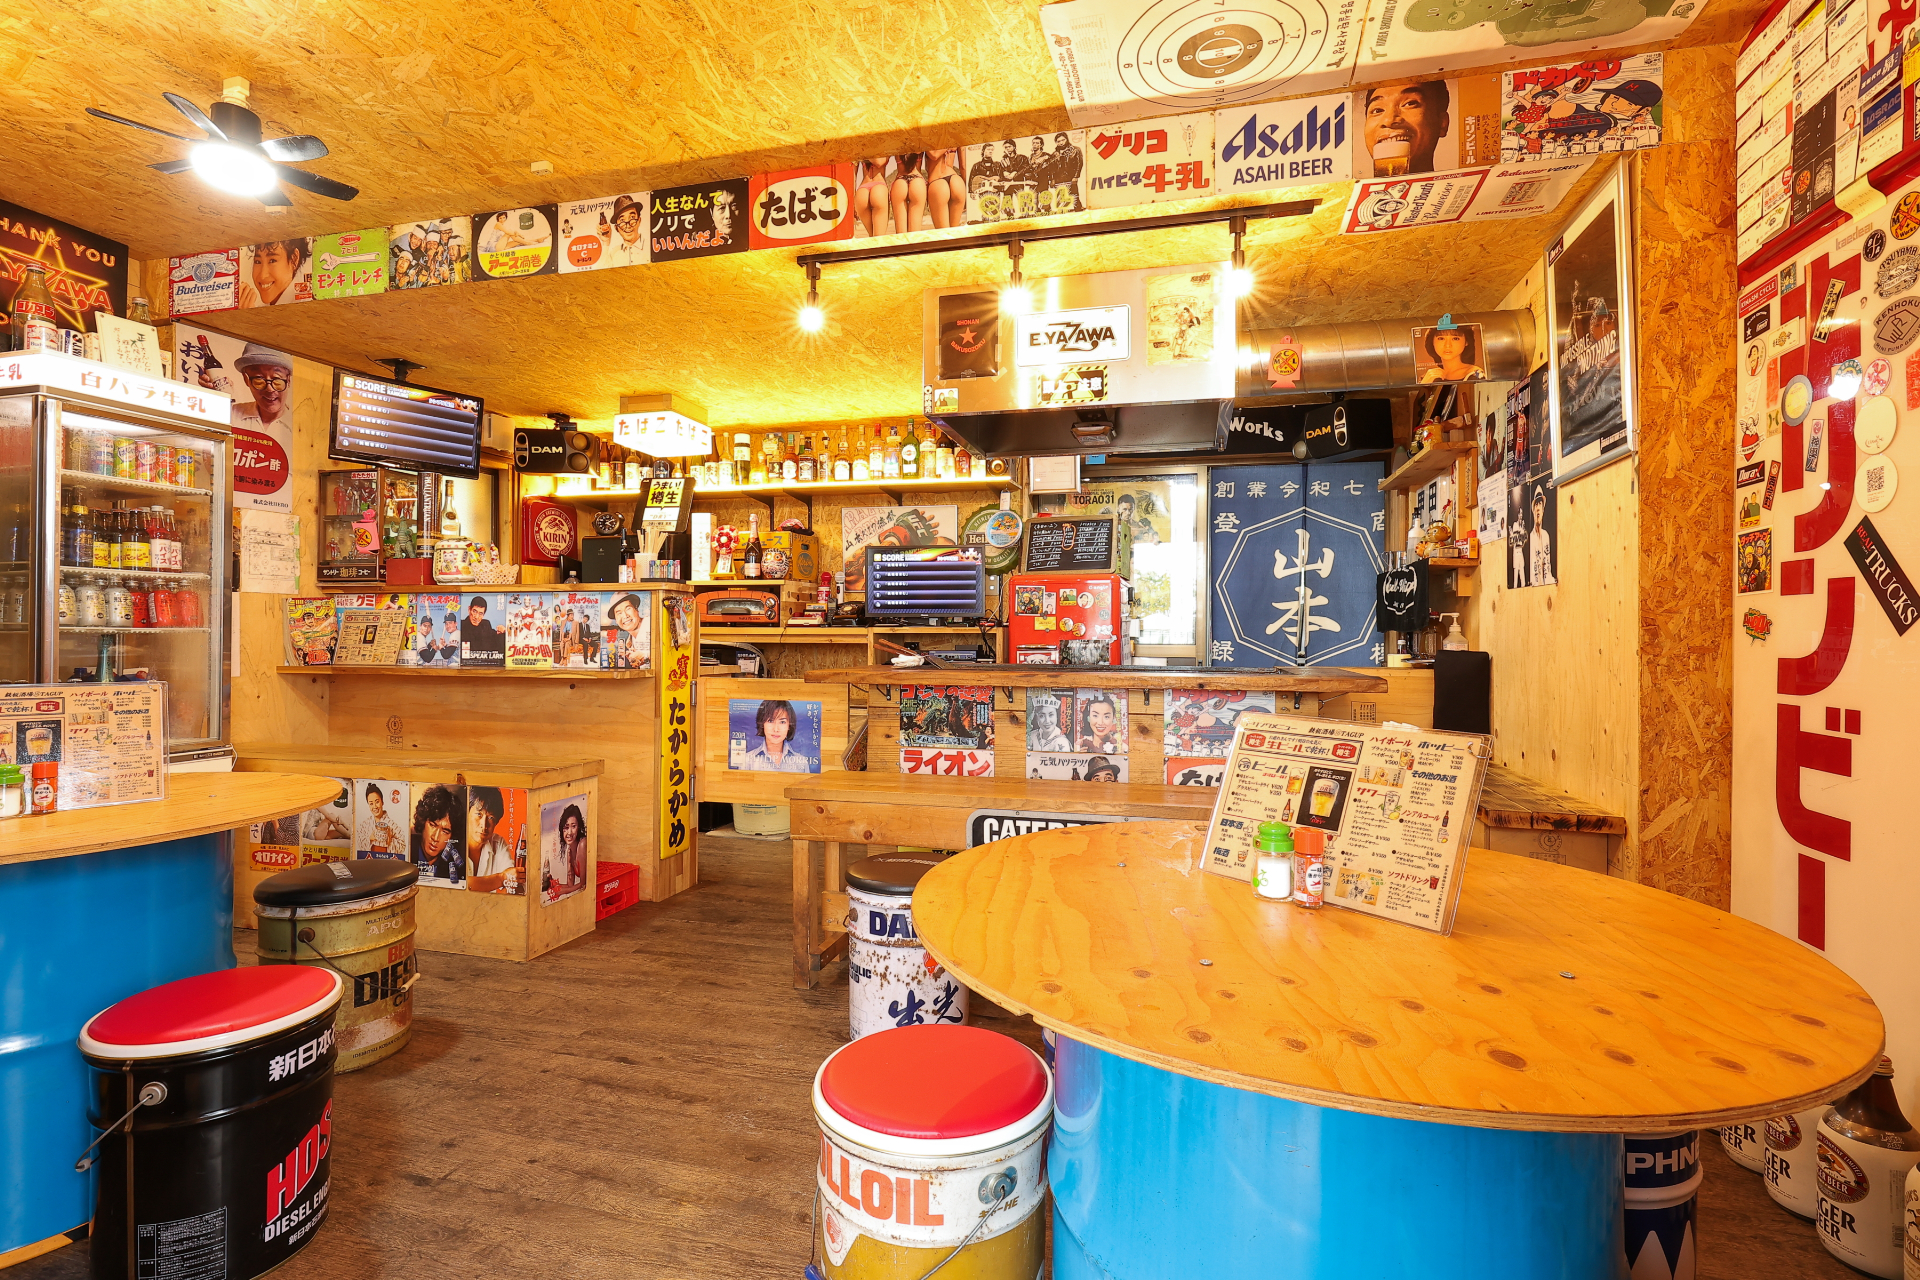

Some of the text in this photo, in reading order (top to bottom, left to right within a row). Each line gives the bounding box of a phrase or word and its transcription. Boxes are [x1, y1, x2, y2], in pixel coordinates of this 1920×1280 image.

[1512, 60, 1622, 92] ドカベン
[1222, 101, 1345, 163] Asahi
[1465, 115, 1476, 165] キリンビール
[1091, 129, 1168, 160] グリコ
[1091, 161, 1210, 193] ハイビタ牛乳
[1233, 157, 1333, 185] ASAHI BEER
[569, 200, 614, 216] 元気ハツラツ!
[651, 191, 724, 214] 人生なんて
[760, 187, 841, 229] たばこ
[1403, 198, 1425, 225] Wasted
[1475, 204, 1545, 216] LIMITED EDITION
[651, 214, 696, 234] ノリで
[571, 243, 599, 251] オロナミン
[652, 230, 726, 252] いいんだよ
[71, 241, 116, 267] YOU
[488, 253, 542, 271] アース渦巻
[174, 280, 233, 296] Budweiser
[956, 318, 980, 326] SHONAN
[950, 338, 987, 353] BAKUSOZOKU
[1560, 332, 1590, 370] IMPOSSIBLE
[1580, 329, 1617, 375] NOTHING
[80, 371, 207, 414] 白バラ牛乳
[355, 379, 387, 394] SCORE
[618, 416, 708, 447] たばこ たばこ
[1228, 415, 1285, 443] Works
[1306, 425, 1331, 440] DAM
[531, 446, 563, 454] DAM
[653, 481, 682, 491] うまい!
[650, 491, 679, 504] 樽生
[908, 514, 929, 539] UFC
[1213, 512, 1241, 534] 登
[543, 531, 567, 544] KIRIN
[1857, 525, 1873, 552] REAL
[160, 546, 168, 564] バイス
[882, 554, 904, 562] SCORE
[1265, 528, 1342, 648] 山本
[1864, 545, 1918, 625] TRUCKS
[1211, 640, 1235, 662] 録
[1341, 731, 1364, 739] TAGUP
[1369, 736, 1413, 748] ハイボール
[1417, 741, 1465, 753] ホッピー
[746, 755, 819, 766] PHILIP MORRIS
[904, 750, 991, 777] ライオン
[1039, 757, 1088, 768] 元気ハツラツ!
[1252, 761, 1288, 775] ビール
[667, 697, 688, 849] たからかめ
[1411, 770, 1457, 783] その他のお酒
[1400, 809, 1441, 822] ノンアルコール
[254, 851, 291, 864] オロナイン
[503, 879, 518, 888] Coke
[1387, 870, 1430, 886] ソフトドリンク
[505, 886, 516, 895] Yes
[366, 912, 400, 925] MULTI GRADE
[888, 981, 963, 1029] 出光
[378, 1040, 394, 1051] KOSAN
[1843, 1156, 1863, 1178] LIMITED
[1827, 1176, 1849, 1195] BEER
[264, 1207, 312, 1243] DIESEL
